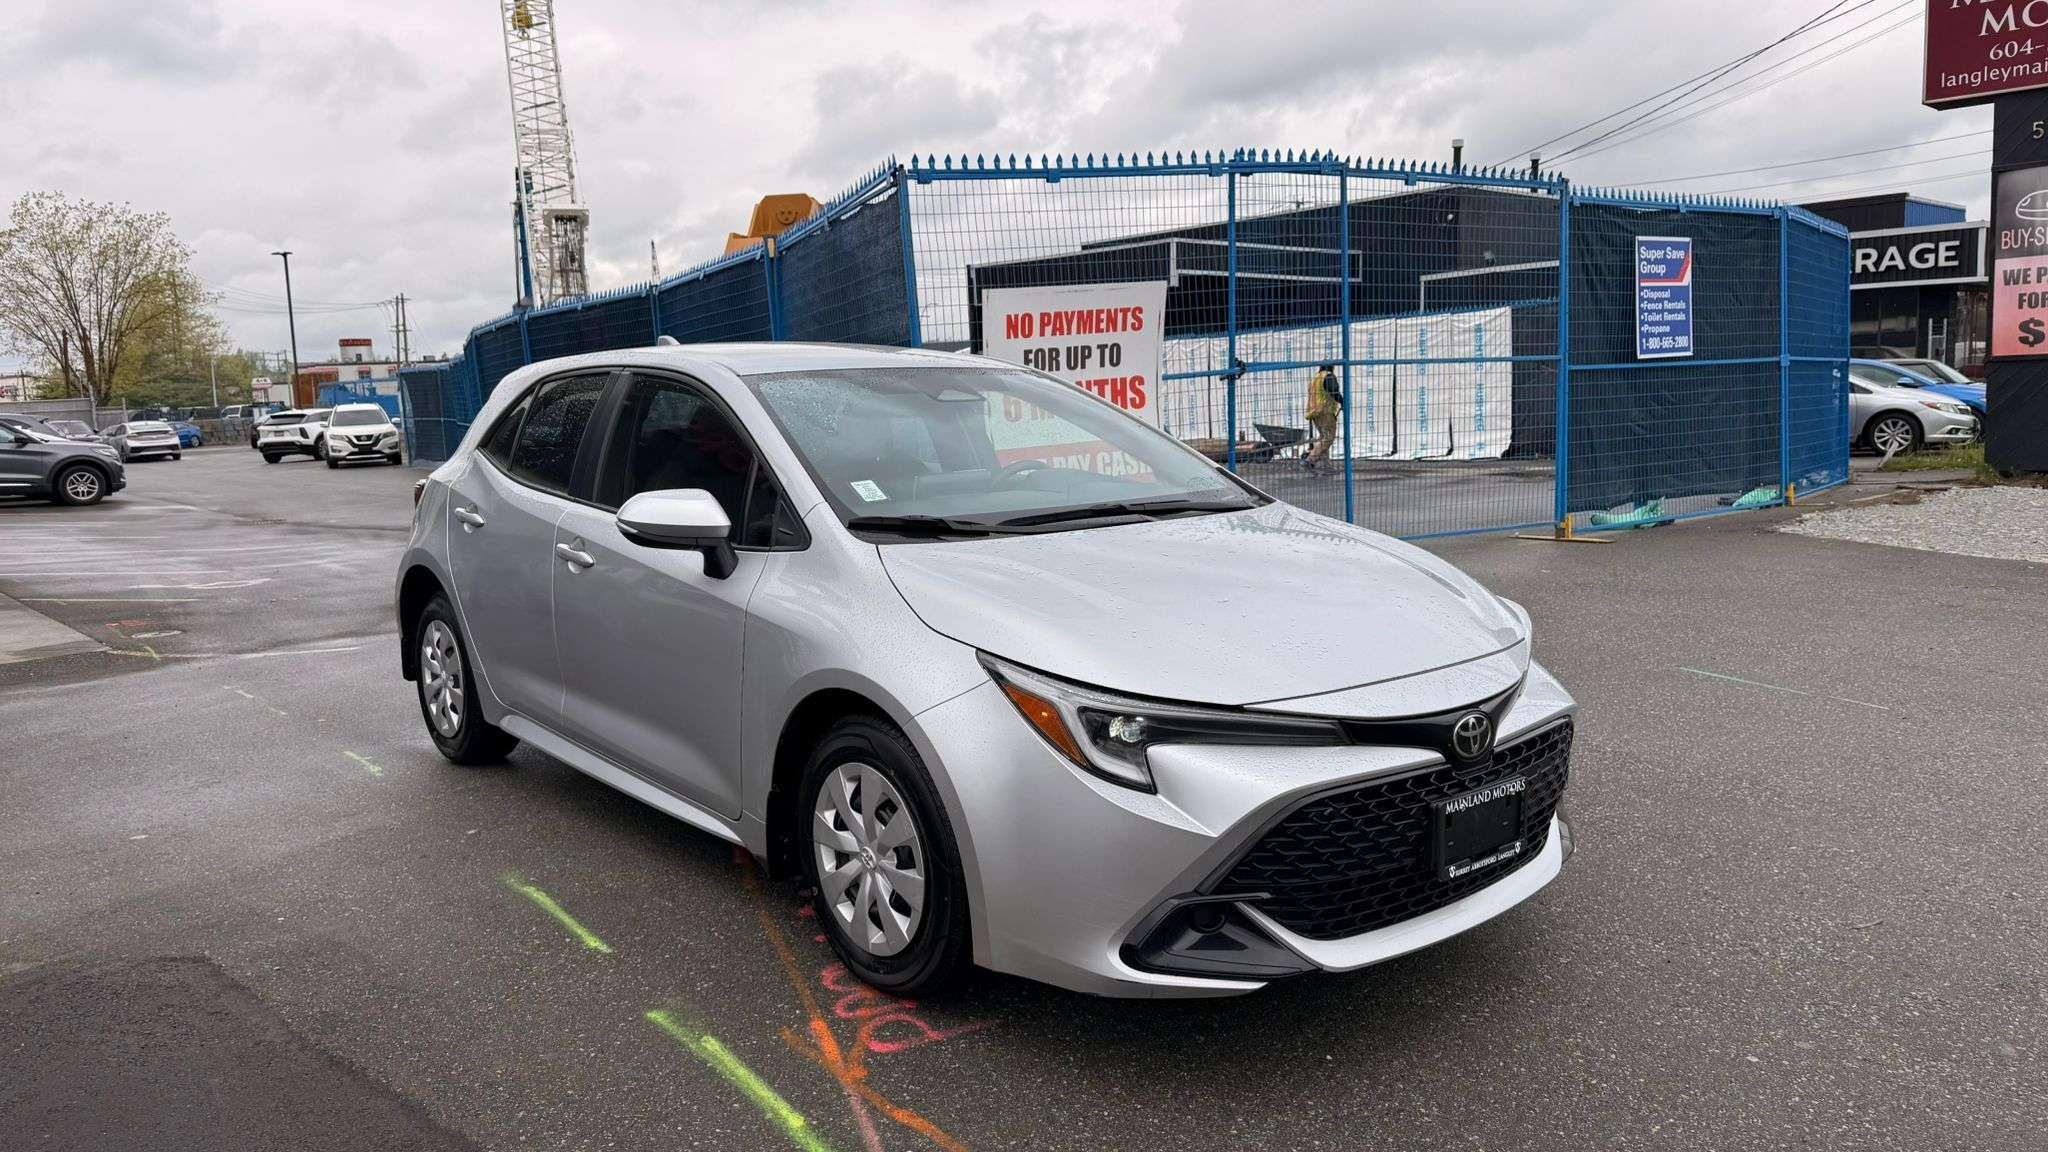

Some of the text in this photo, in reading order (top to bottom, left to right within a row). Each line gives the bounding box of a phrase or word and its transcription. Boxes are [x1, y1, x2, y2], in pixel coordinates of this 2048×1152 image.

[2032, 121, 2045, 139] 5
[2001, 226, 2048, 250] BUY-S
[1640, 246, 1685, 261] Super Save
[1850, 240, 1961, 275] RAGE
[1640, 261, 1666, 276] Group
[2003, 266, 2048, 286] WE P
[1006, 306, 1144, 339] NO PAYMENTS
[1023, 343, 1122, 372] FOR UP TO
[1075, 375, 1146, 410] THS
[1445, 779, 1526, 815] MAINLAND MOTORS
